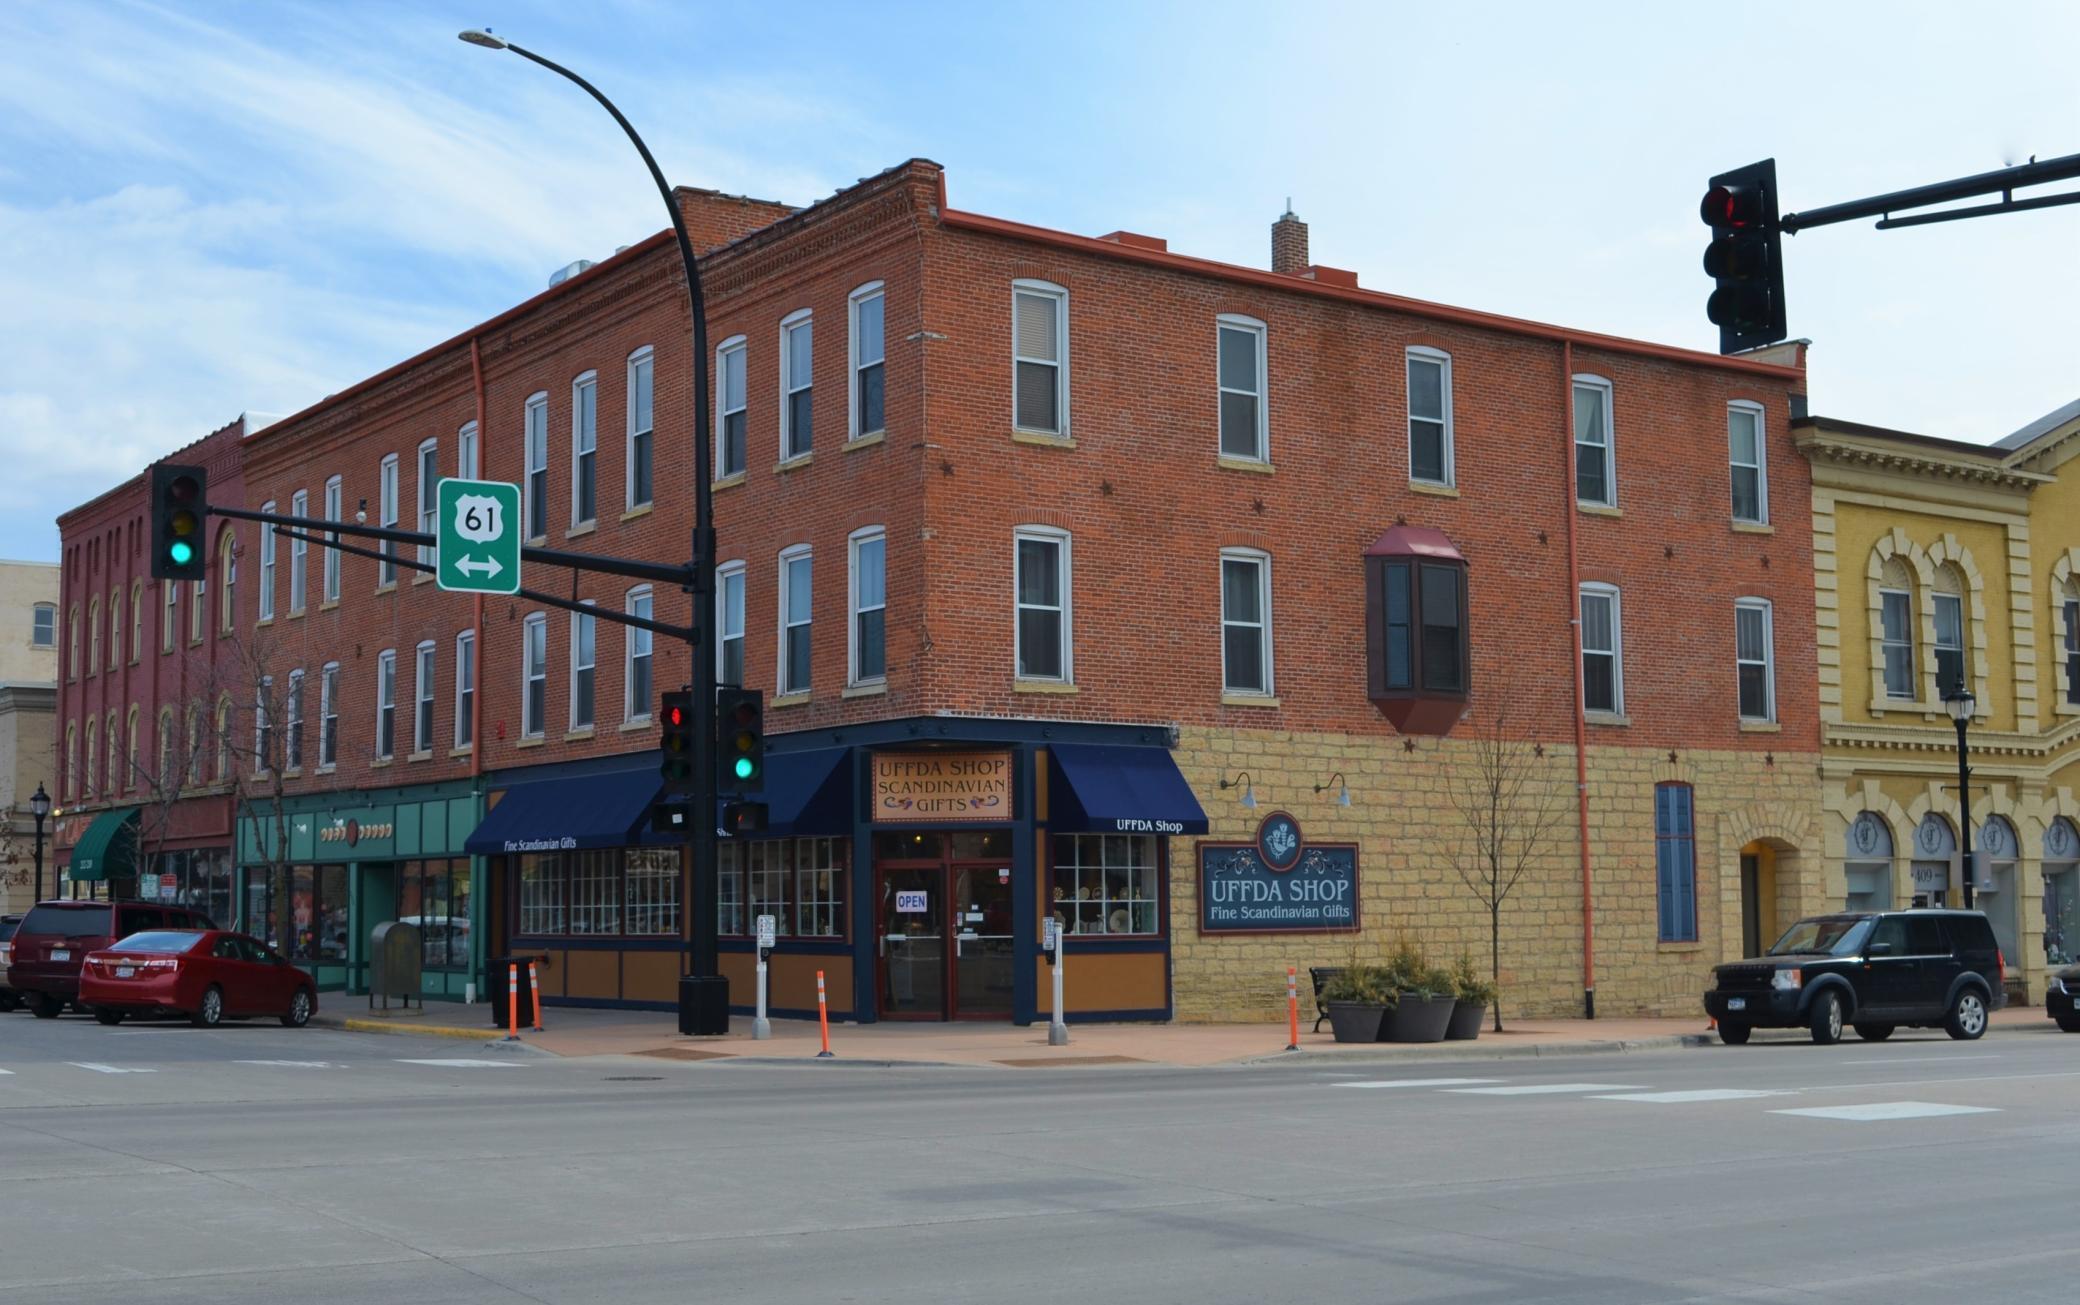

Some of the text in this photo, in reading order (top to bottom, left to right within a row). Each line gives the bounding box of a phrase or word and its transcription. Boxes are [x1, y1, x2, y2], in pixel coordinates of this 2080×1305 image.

[465, 506, 493, 532] 61
[880, 760, 1005, 777] UFFDA SHOP
[878, 780, 1005, 794] SCANDINAVIAN
[916, 798, 967, 812] GIFTS
[1116, 818, 1183, 834] UFFDA Shop
[504, 837, 577, 852] Fine Scandinavian Gifts
[1211, 879, 1349, 901] UFFDA SHOP
[898, 895, 926, 908] OPEN
[1211, 904, 1350, 919] Fine Scandinavian Gifts
